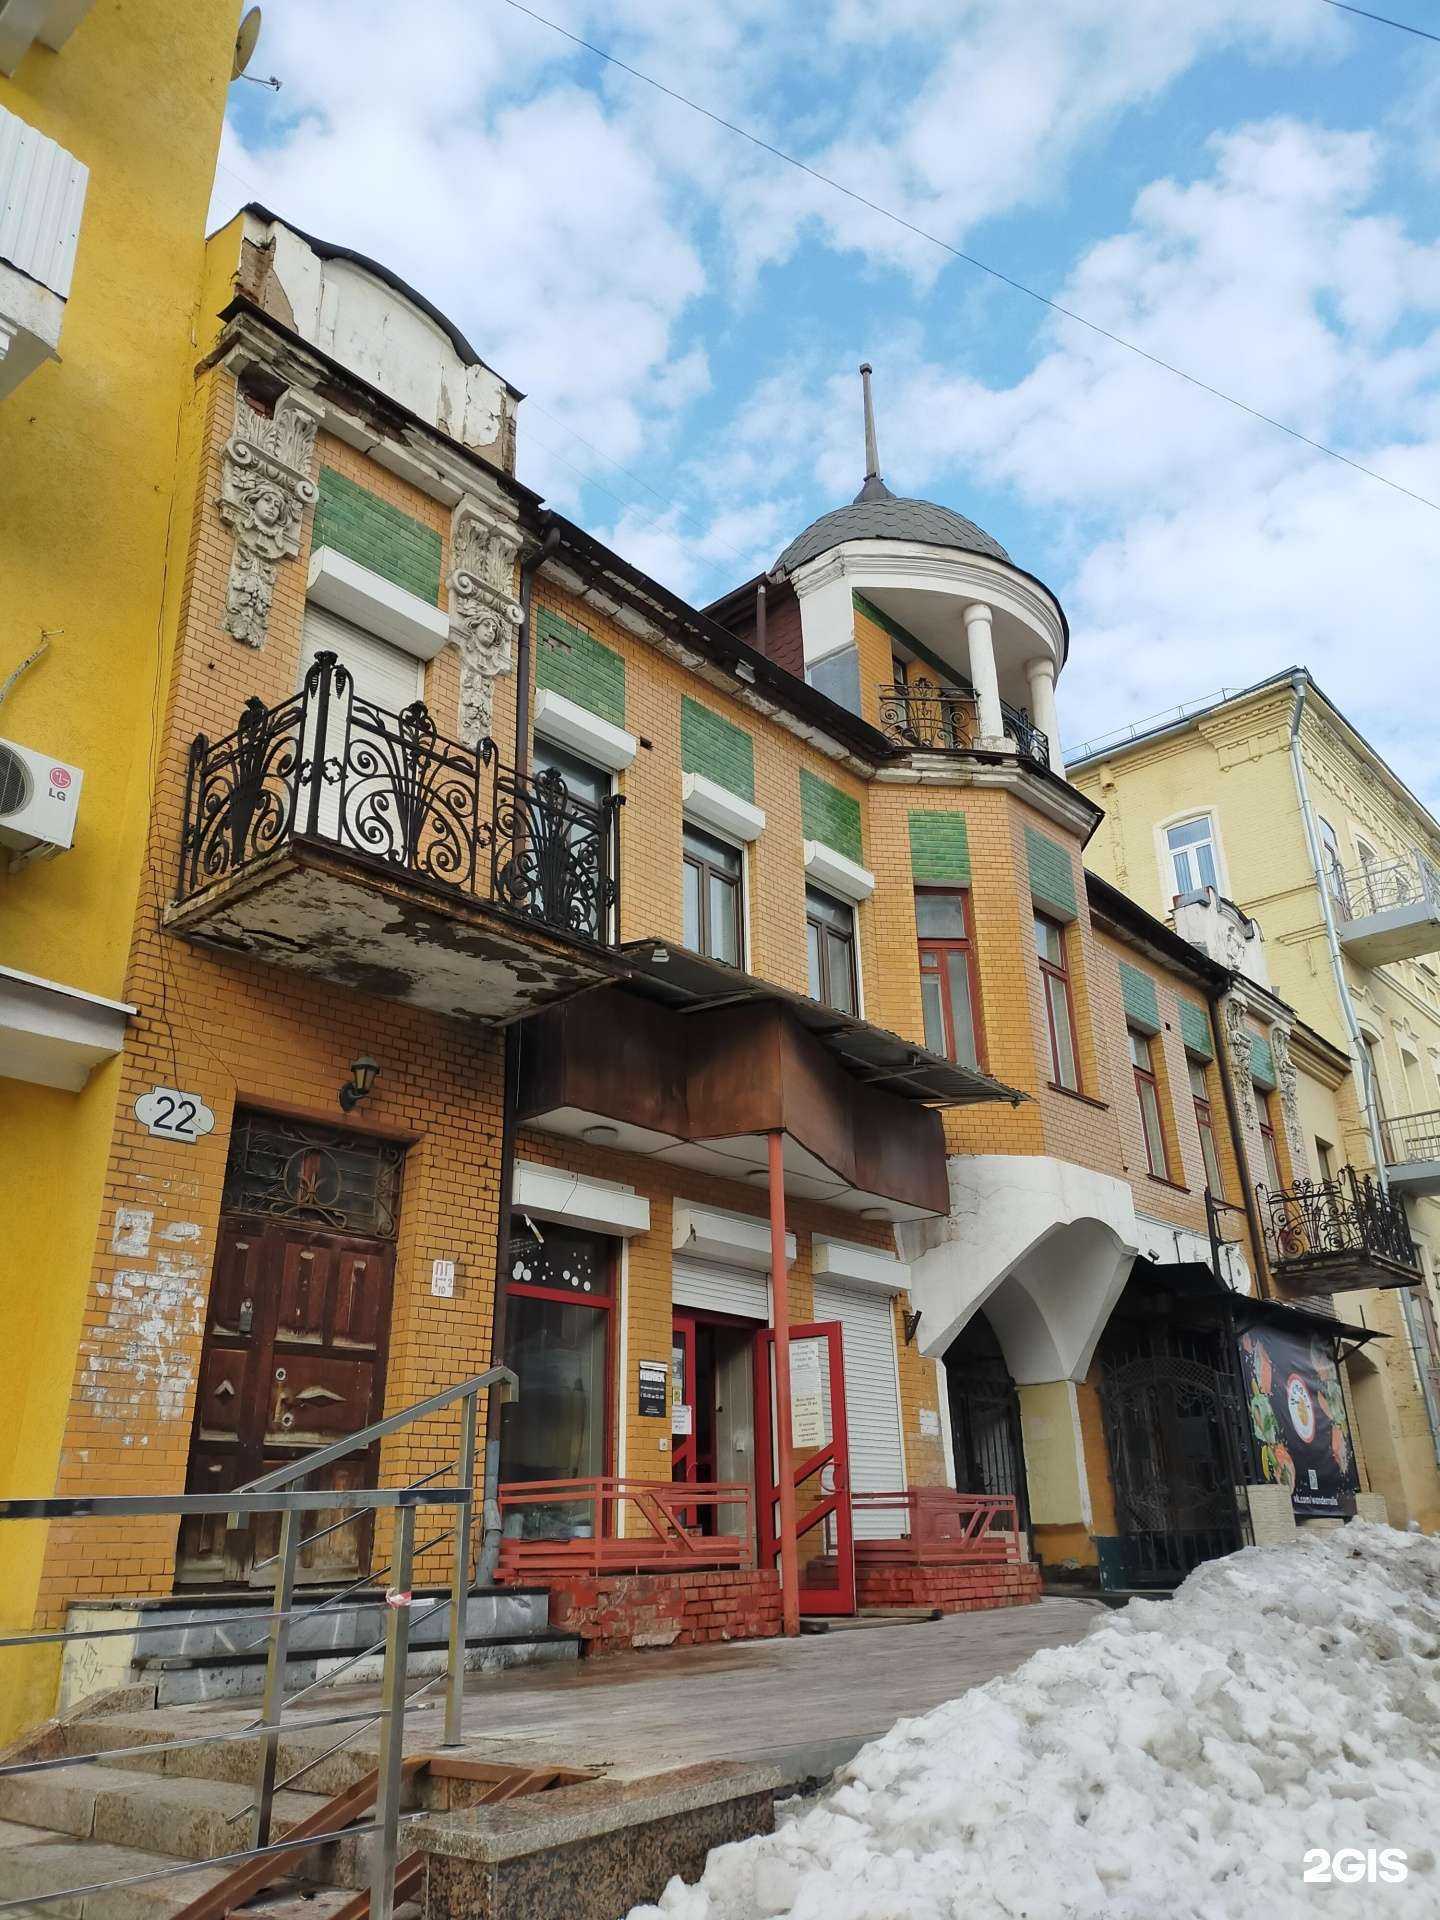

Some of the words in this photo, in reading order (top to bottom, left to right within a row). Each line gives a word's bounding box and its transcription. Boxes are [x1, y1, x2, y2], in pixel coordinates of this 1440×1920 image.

[48, 787, 66, 802] LG
[153, 1096, 196, 1135] 22
[435, 1262, 452, 1276] ПГ
